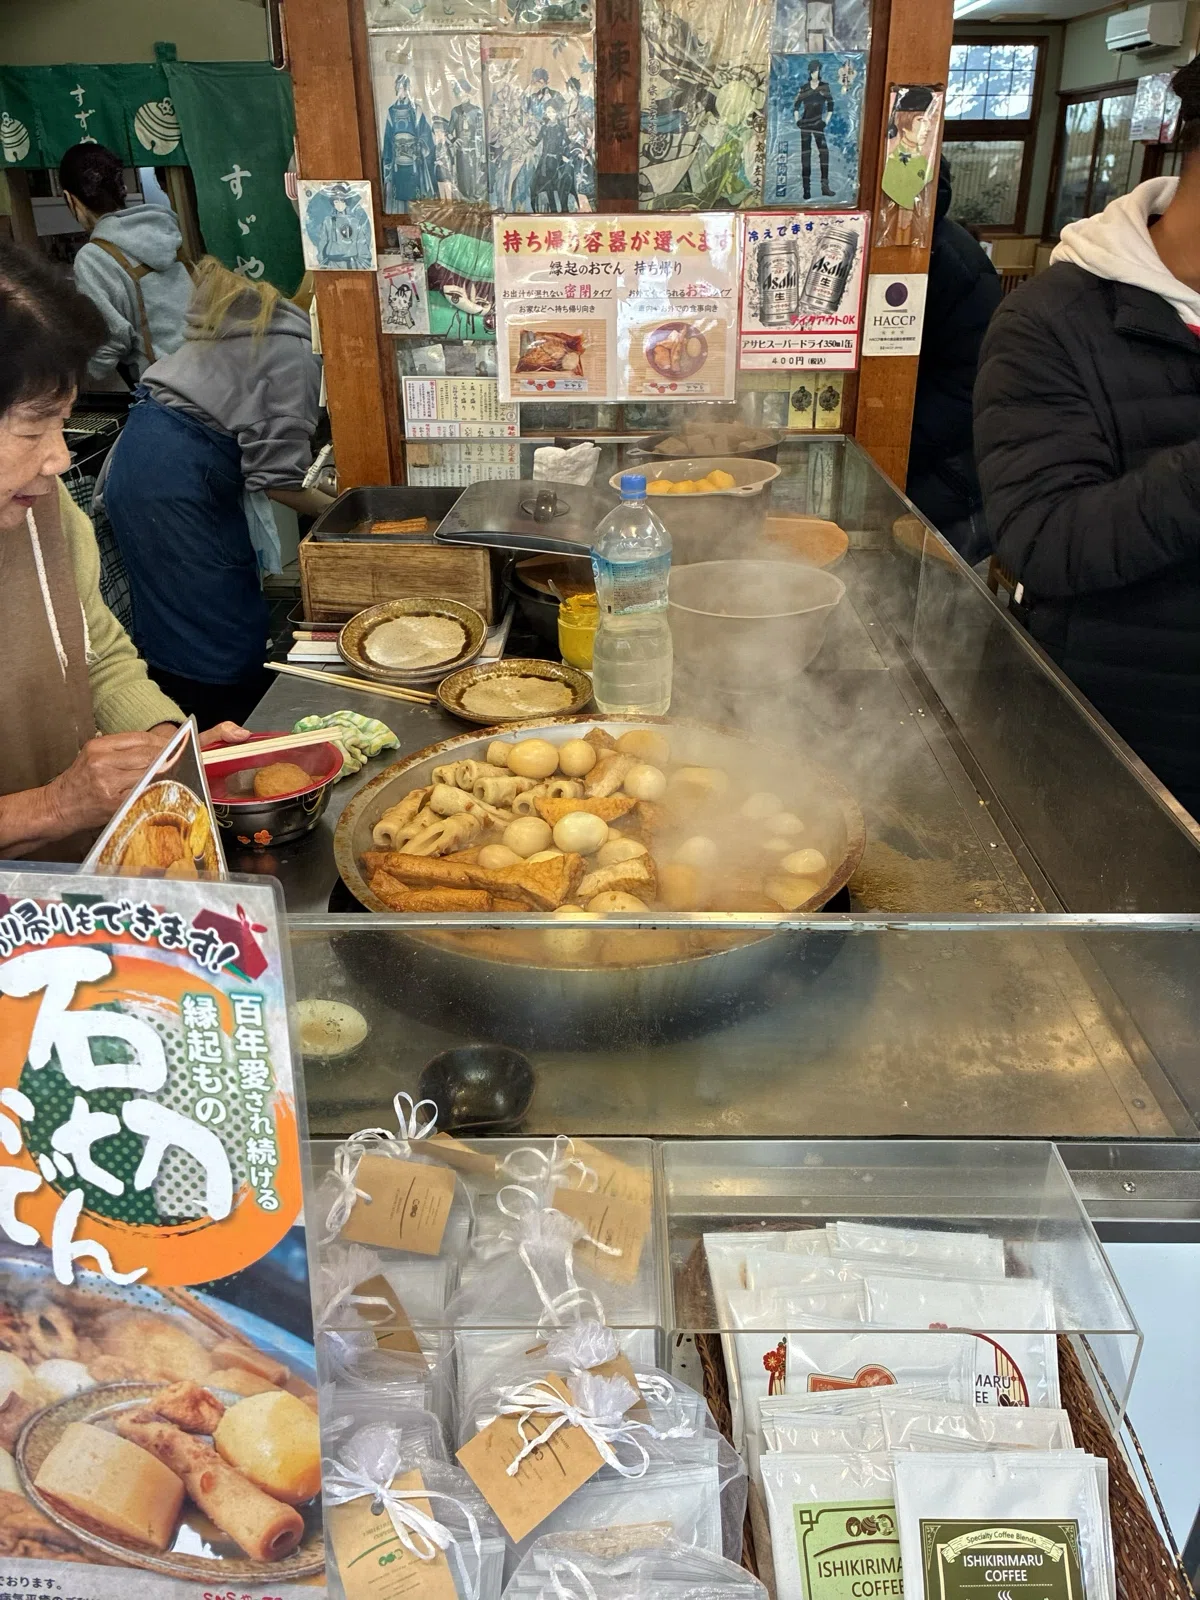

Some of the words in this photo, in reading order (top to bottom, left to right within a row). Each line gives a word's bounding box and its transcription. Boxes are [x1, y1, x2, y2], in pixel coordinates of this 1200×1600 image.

[503, 229, 734, 253] 持ち帰り容器が選べます
[549, 260, 625, 276] 縁起のおでん
[634, 260, 682, 276] 持ち帰り
[762, 271, 796, 290] Asahi
[873, 315, 916, 327] HACCP
[183, 996, 227, 1125] 縁起もの
[231, 993, 280, 1211] 百年愛され続ける
[966, 1532, 993, 1544] Specialty
[994, 1531, 1014, 1539] Coffee
[1016, 1533, 1037, 1544] Blends
[963, 1554, 1044, 1567] ISHIKIRIMARU
[985, 1569, 1028, 1582] COFFEE
[851, 1579, 904, 1598] COFFEE
